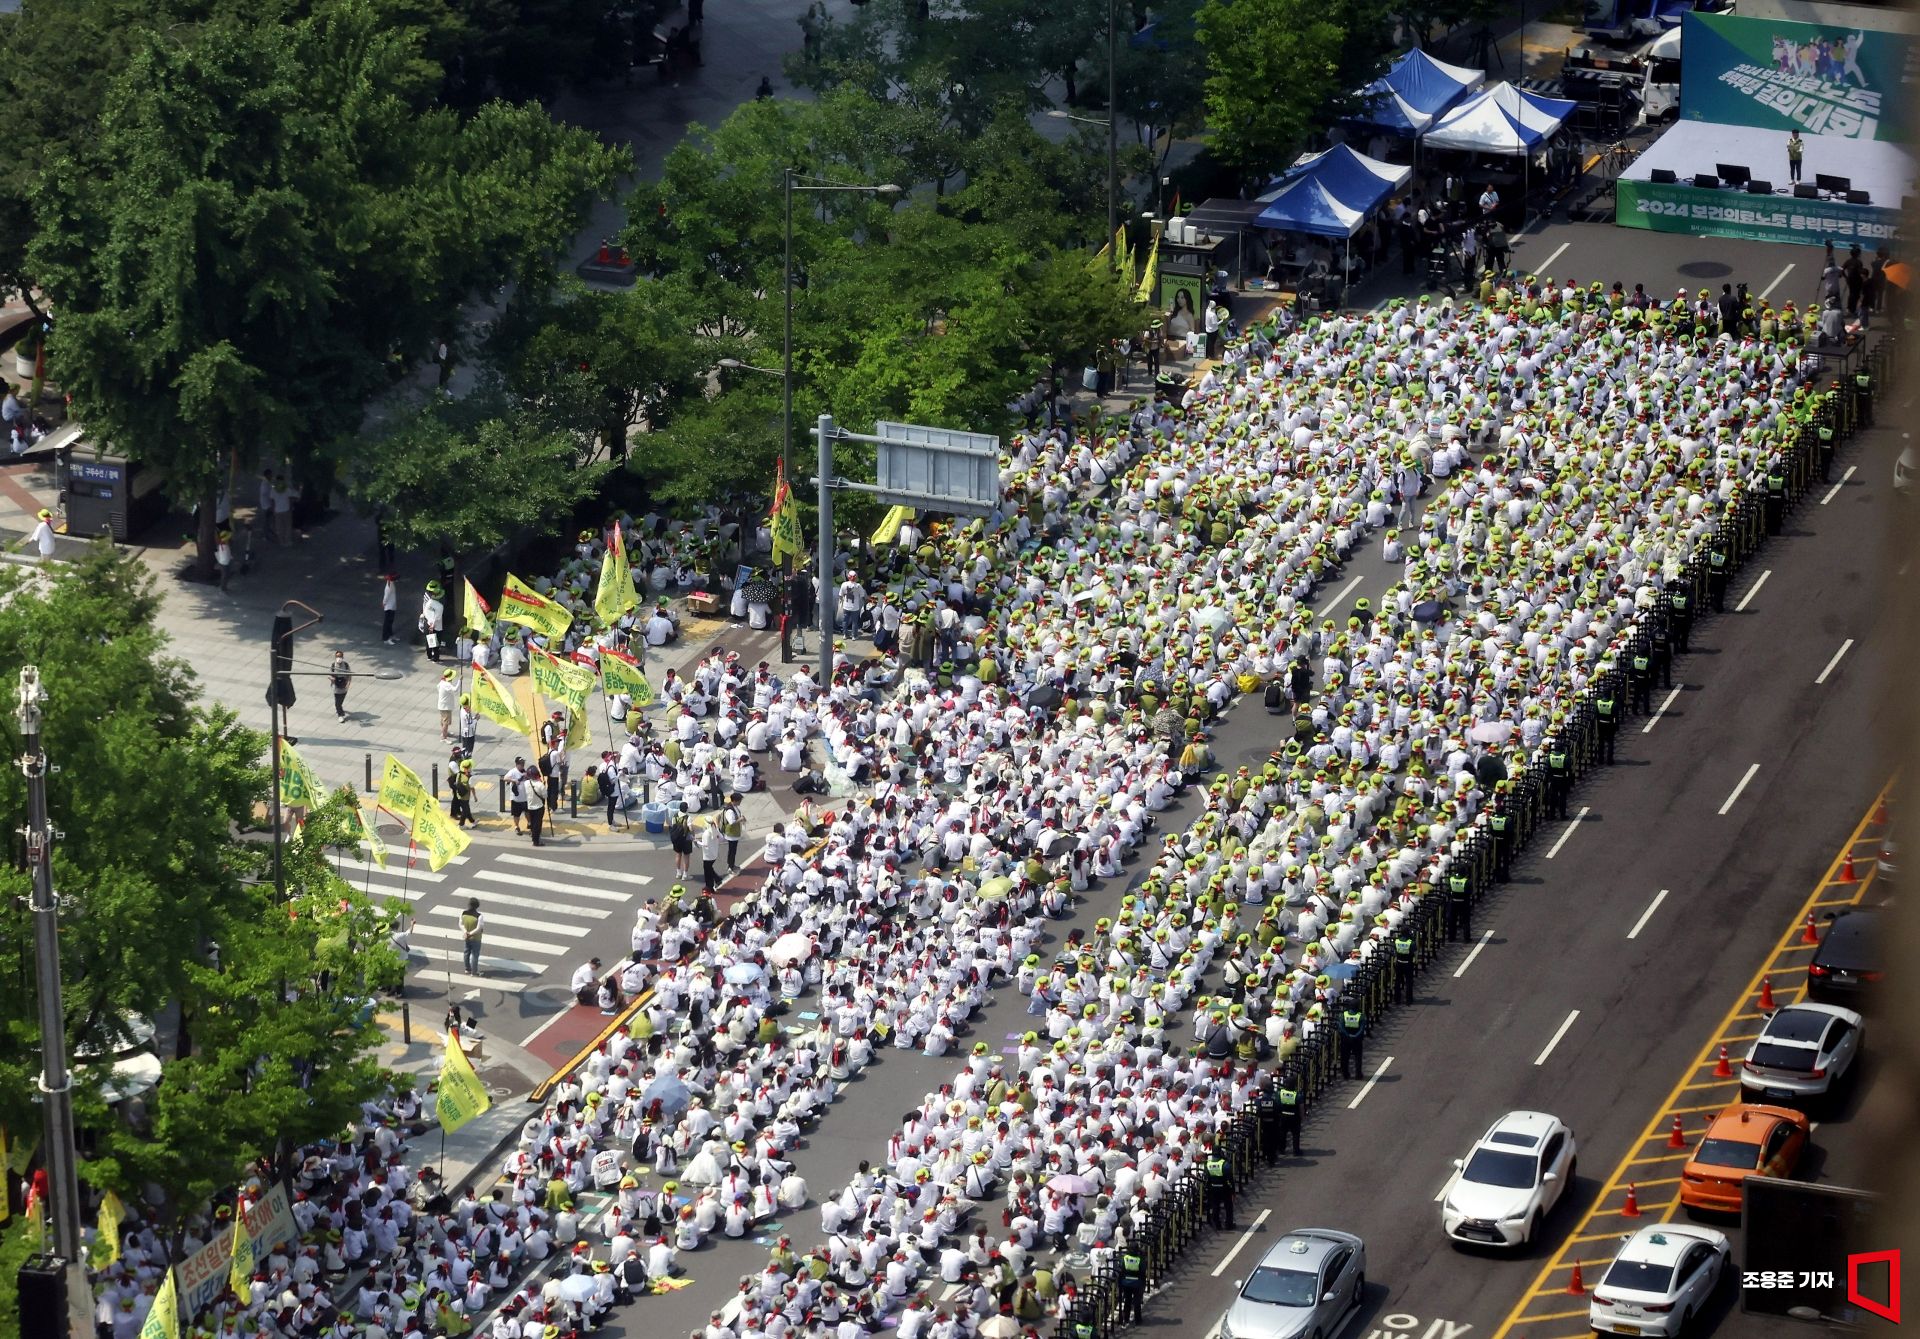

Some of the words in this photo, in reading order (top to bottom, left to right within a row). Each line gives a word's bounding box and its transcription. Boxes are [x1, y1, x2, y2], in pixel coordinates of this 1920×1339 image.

[1753, 83, 1879, 140] 결의대회
[1760, 68, 1882, 115] 보건의료노조
[1636, 199, 1689, 217] 2024
[1691, 204, 1788, 228] 보건의료노조
[1790, 214, 1855, 235] 총력투쟁
[85, 467, 104, 478] 구두수선
